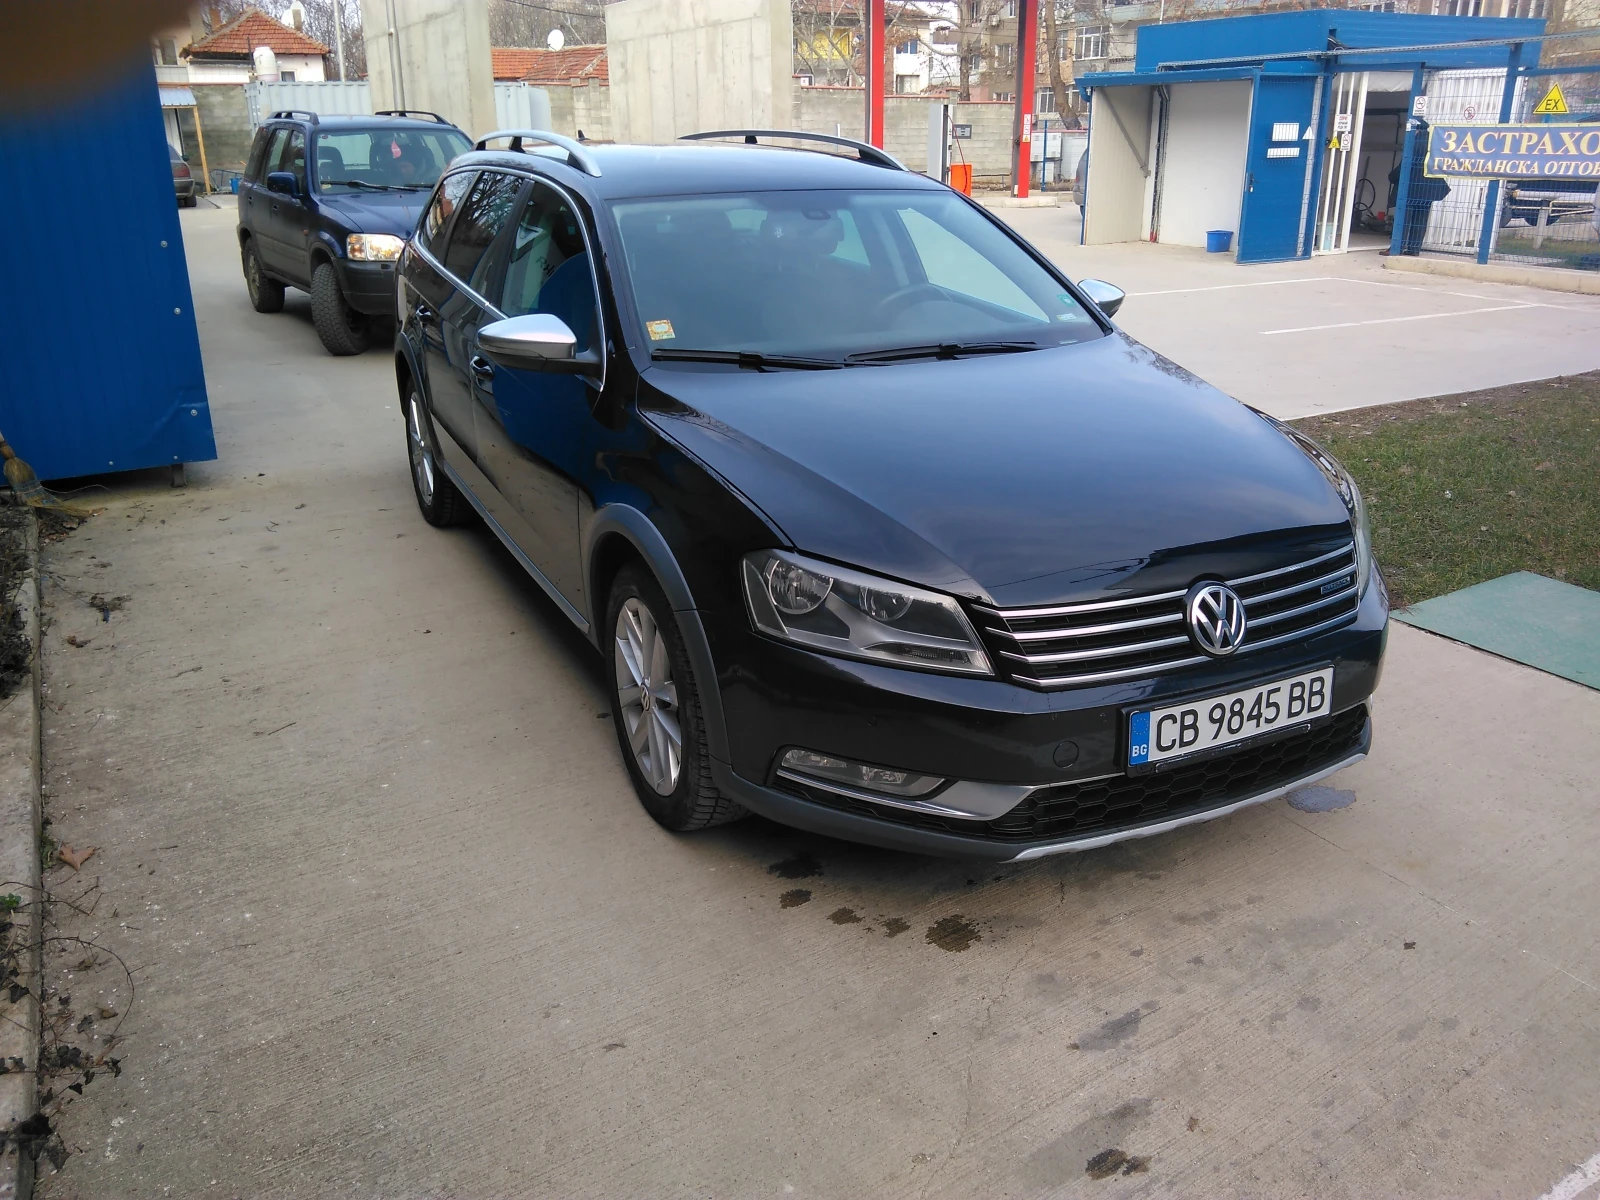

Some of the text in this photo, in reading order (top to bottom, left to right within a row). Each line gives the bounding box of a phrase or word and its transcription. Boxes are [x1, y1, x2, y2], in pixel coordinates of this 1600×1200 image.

[1545, 98, 1559, 111] EX
[1441, 131, 1600, 156] ЗАСТРАХО
[1433, 157, 1539, 175] ГРАЖДАНСКА
[1191, 586, 1245, 655] VW
[1156, 676, 1325, 752] CB 9845 BB
[1132, 744, 1147, 757] BG
